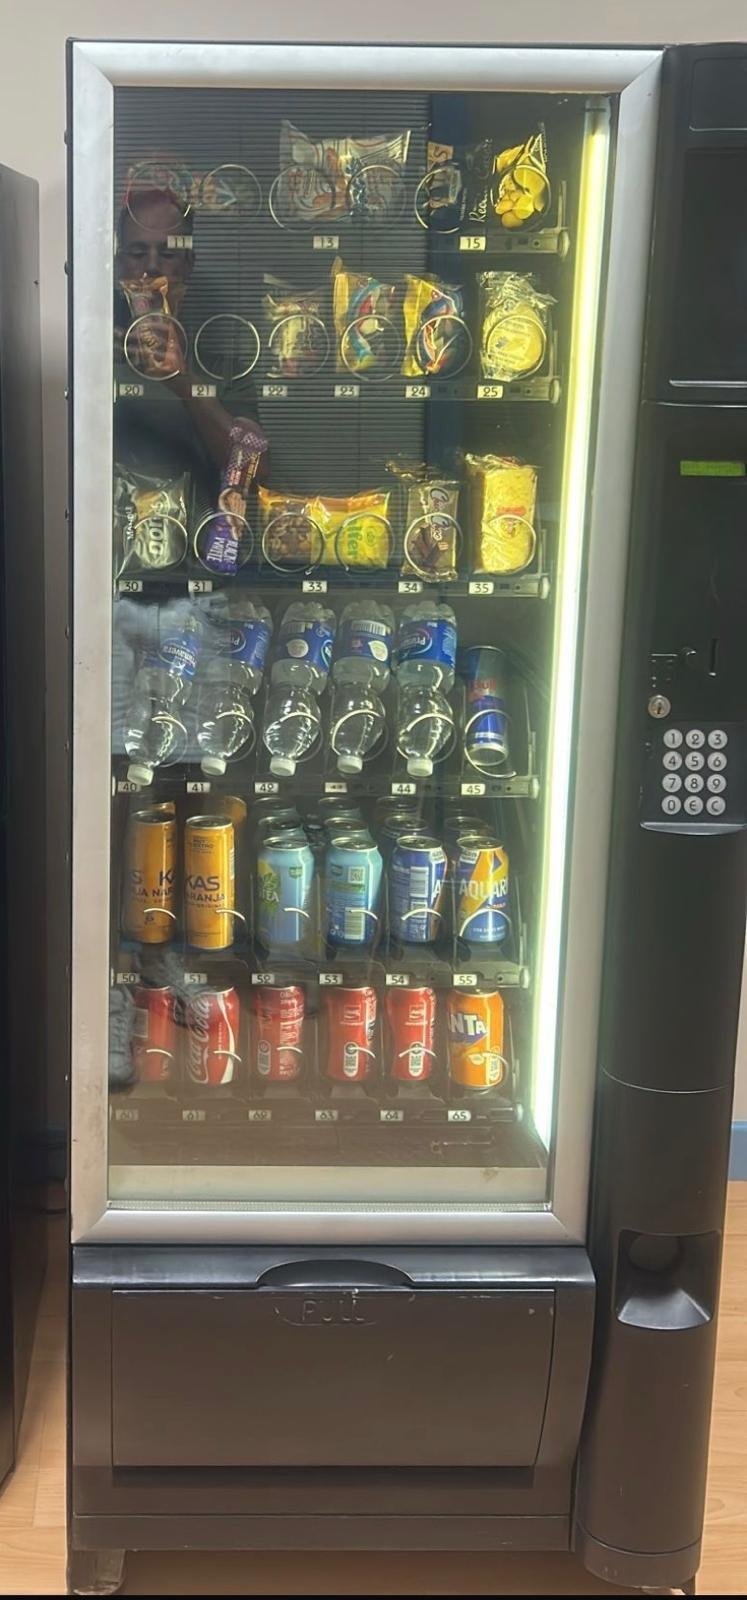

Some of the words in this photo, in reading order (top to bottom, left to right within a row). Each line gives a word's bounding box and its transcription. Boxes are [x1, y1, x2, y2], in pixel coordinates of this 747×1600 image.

[173, 237, 185, 248] 11
[320, 237, 334, 248] 13
[466, 238, 481, 249] 15
[125, 386, 140, 397] 20
[197, 386, 210, 397] 21
[268, 386, 282, 397] 22
[340, 386, 355, 397] 23
[411, 386, 426, 397] 24
[483, 386, 498, 397] 25
[125, 581, 139, 591] 30
[193, 581, 206, 591] 31
[309, 581, 323, 592] 33
[404, 582, 418, 593] 34
[475, 582, 489, 593] 35
[670, 733, 676, 744] 1
[691, 733, 700, 745] 2
[714, 734, 721, 745] 3
[668, 755, 676, 766] 4
[691, 756, 698, 767] 5
[713, 757, 721, 767] 6
[123, 783, 137, 792] 40
[191, 783, 205, 792] 41
[259, 783, 274, 793] 42
[397, 784, 411, 794] 44
[669, 778, 676, 788] 7
[690, 778, 698, 789] 8
[713, 778, 720, 789] 9
[466, 784, 481, 795] 45
[668, 800, 675, 811] 0
[711, 801, 719, 811] C
[122, 974, 136, 983] 50
[189, 974, 200, 983] 51
[256, 975, 271, 984] 52
[324, 975, 339, 984] 53
[392, 975, 405, 985] 54
[459, 975, 473, 985] 55
[319, 1111, 334, 1121] 63
[385, 1111, 399, 1121] 64
[453, 1111, 467, 1121] 65
